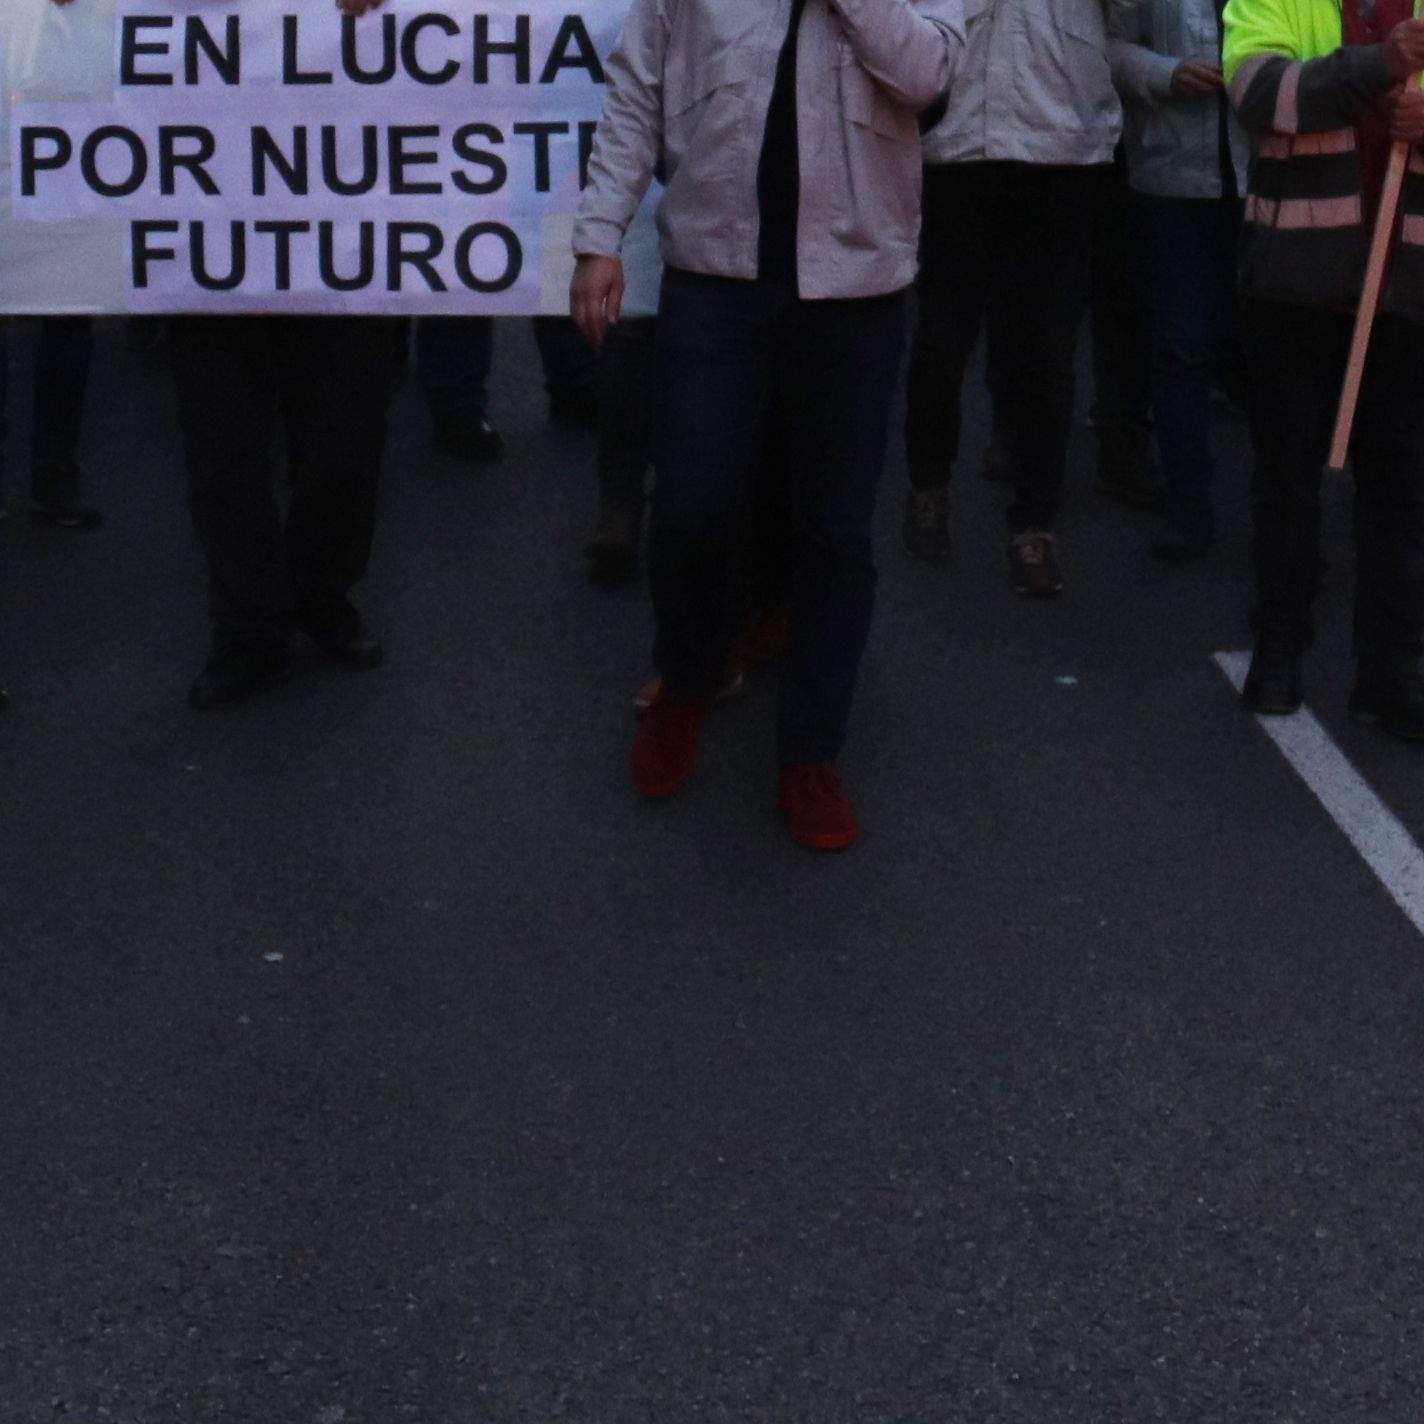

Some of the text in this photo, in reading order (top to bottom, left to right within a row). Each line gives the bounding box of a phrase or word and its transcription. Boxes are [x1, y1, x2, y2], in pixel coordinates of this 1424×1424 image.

[119, 14, 605, 86] EN LUCHA
[19, 121, 597, 197] POR NUEST
[130, 219, 523, 292] FUTURO
